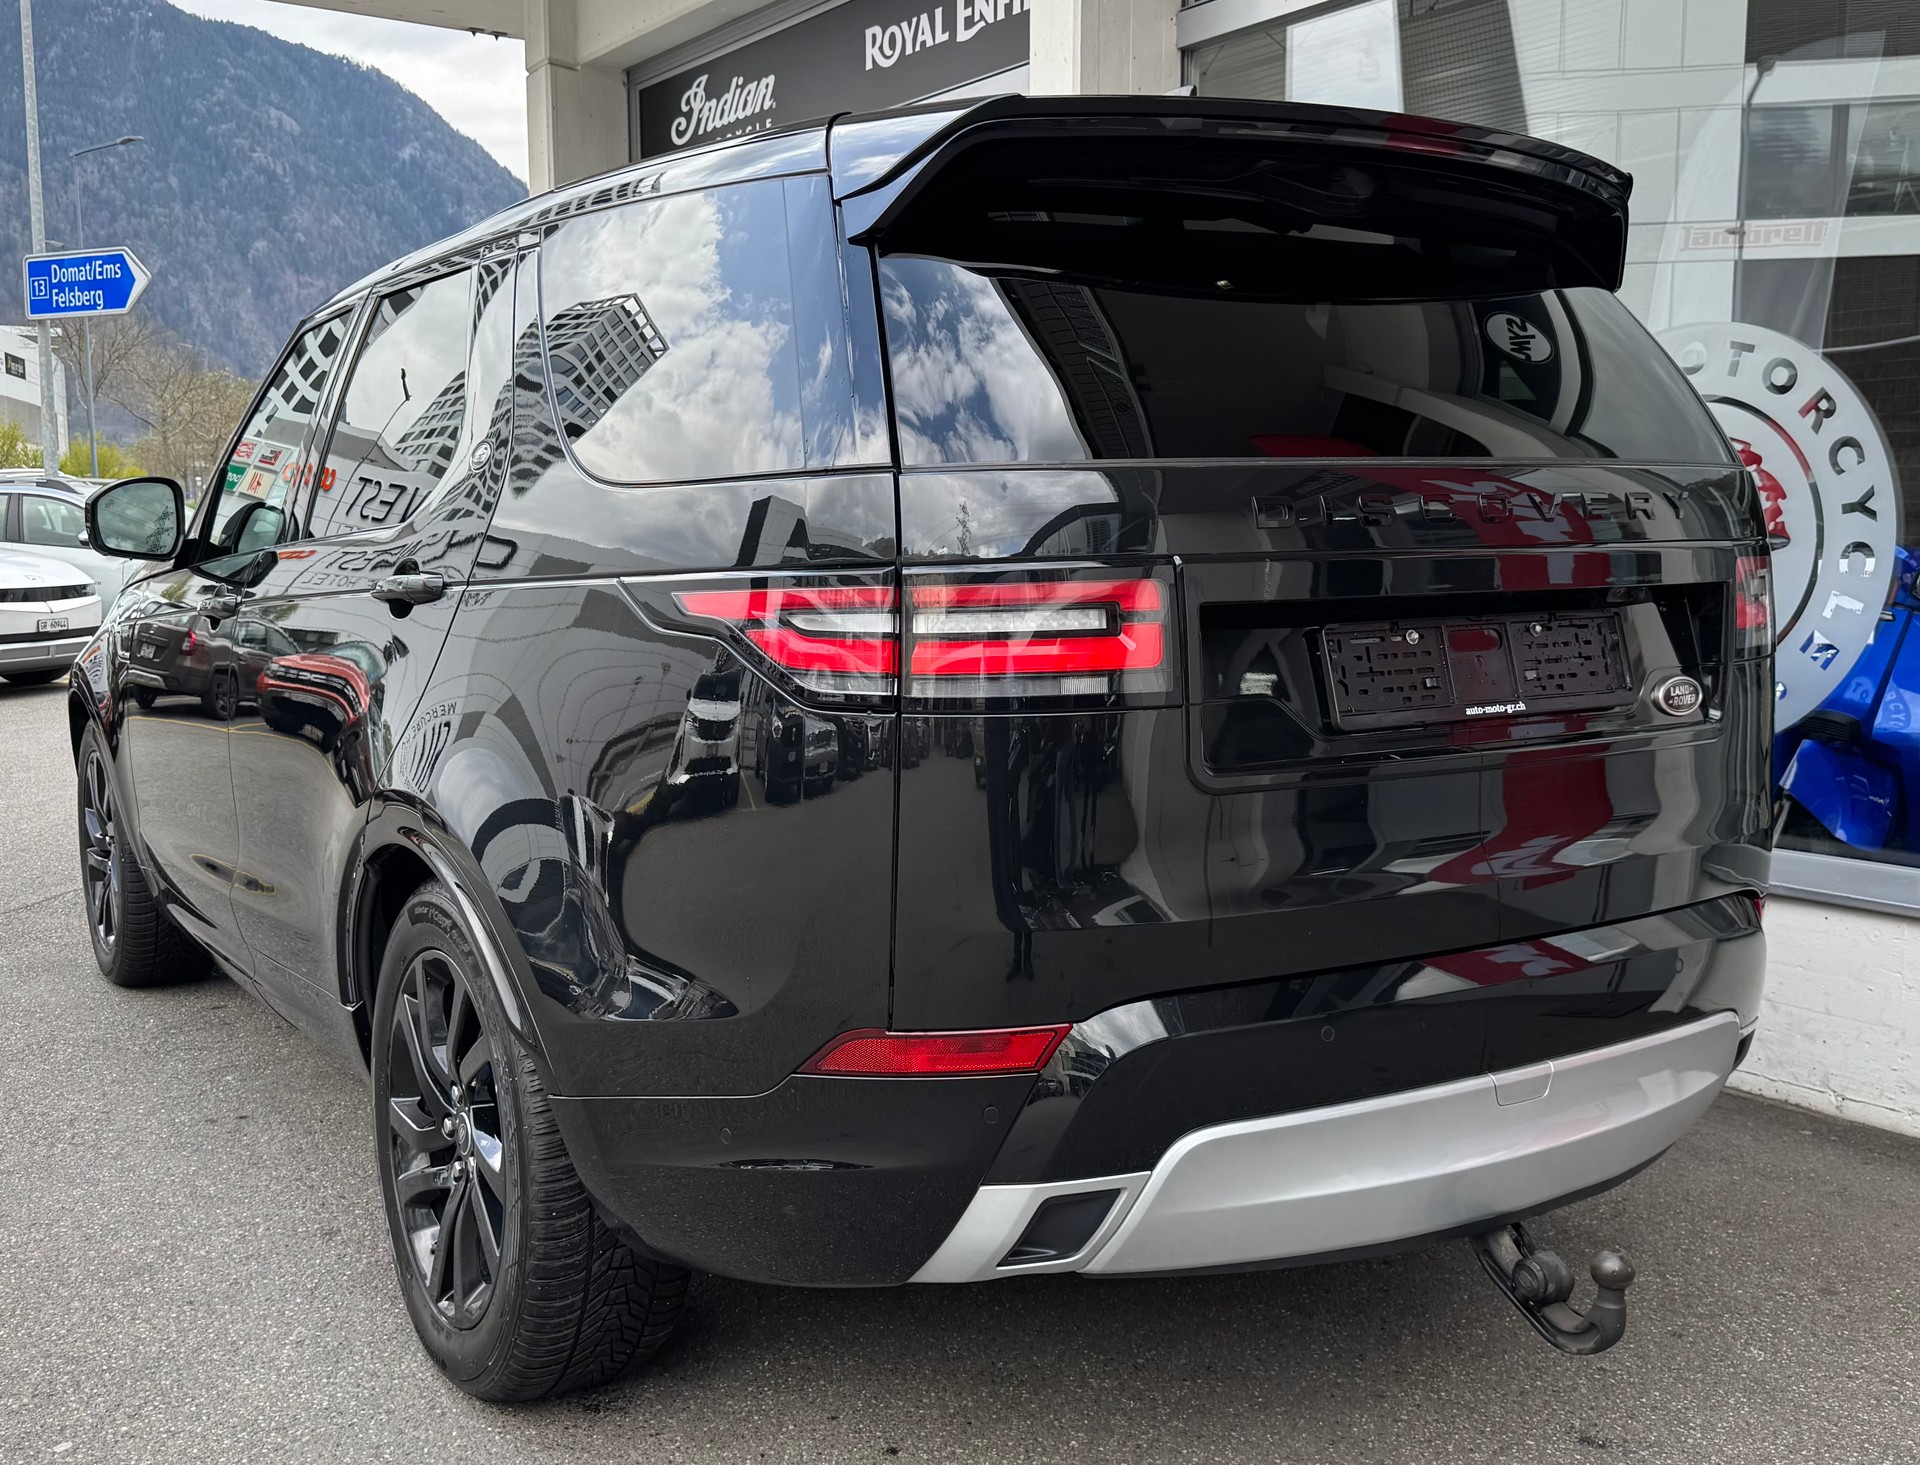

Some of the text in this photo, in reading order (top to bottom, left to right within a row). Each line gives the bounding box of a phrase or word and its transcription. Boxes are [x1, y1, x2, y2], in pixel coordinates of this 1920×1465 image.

[865, 6, 949, 71] ROYAL
[51, 260, 121, 283] Domat/Ems
[33, 281, 46, 296] 13
[52, 286, 104, 310] Felsberg
[1251, 490, 1689, 530] DISCOVERY
[1681, 341, 1878, 671] OTORCYCLE
[1670, 685, 1690, 697] LAND
[1672, 694, 1696, 706] ROVER
[1465, 700, 1526, 715] auto-moto-gr.ch
